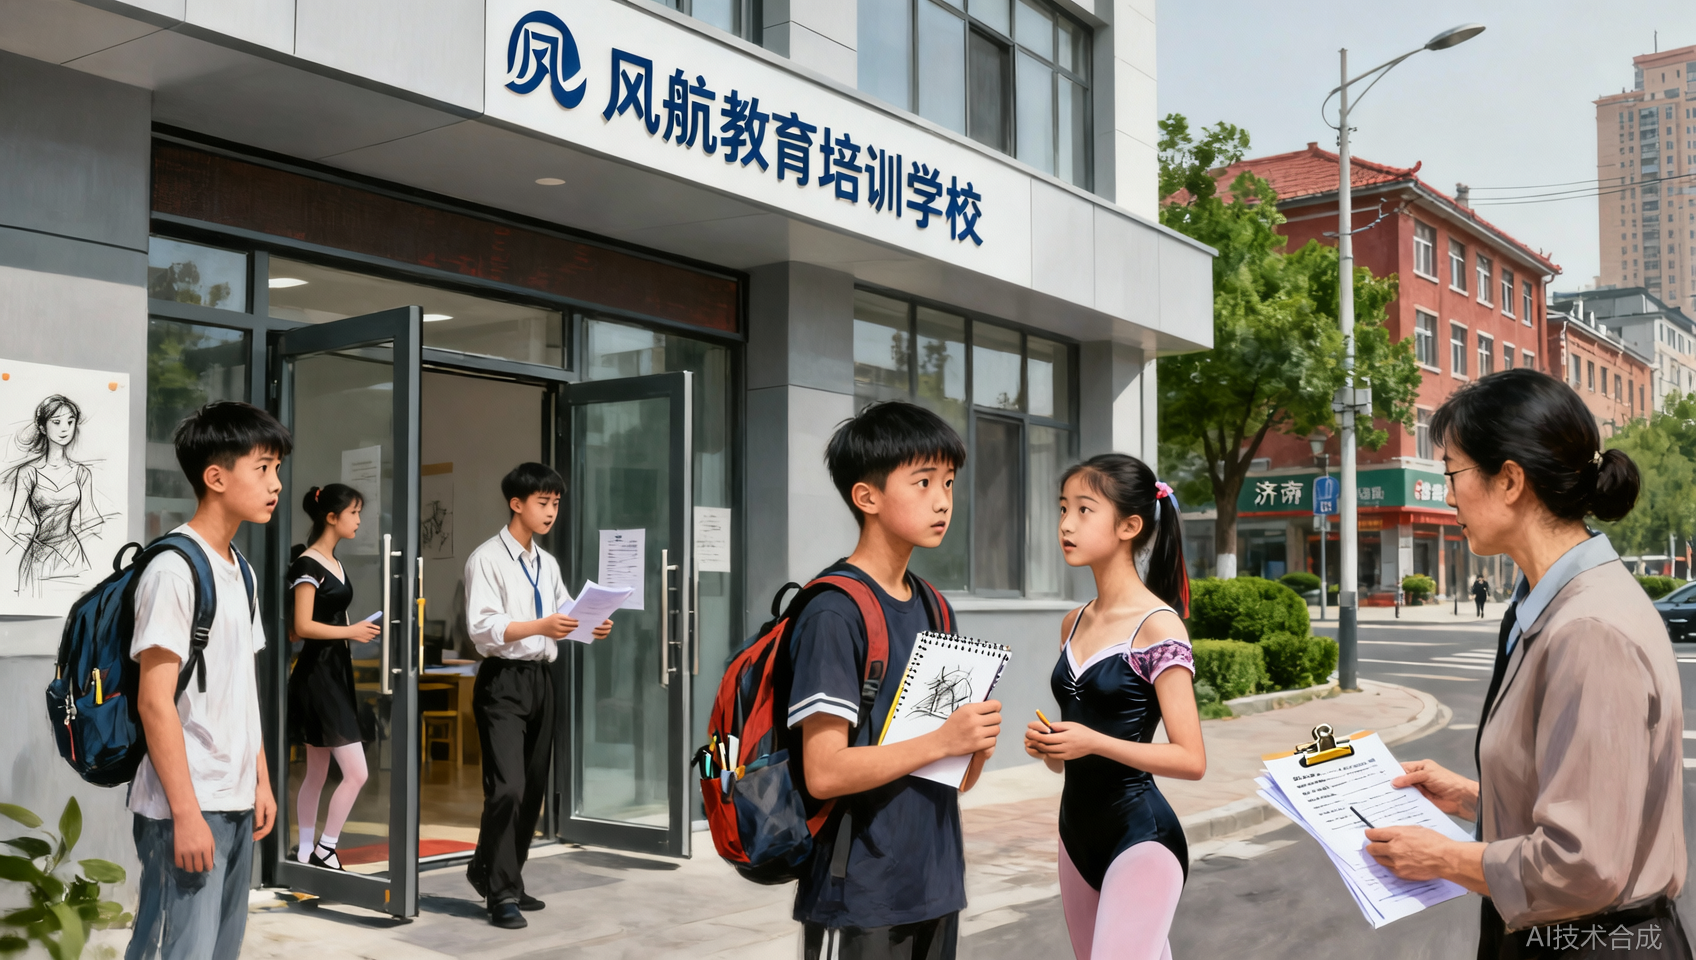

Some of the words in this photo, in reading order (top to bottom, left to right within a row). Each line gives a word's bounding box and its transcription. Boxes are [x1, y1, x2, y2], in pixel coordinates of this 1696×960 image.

[603, 47, 983, 246] 风航教育培训学校
